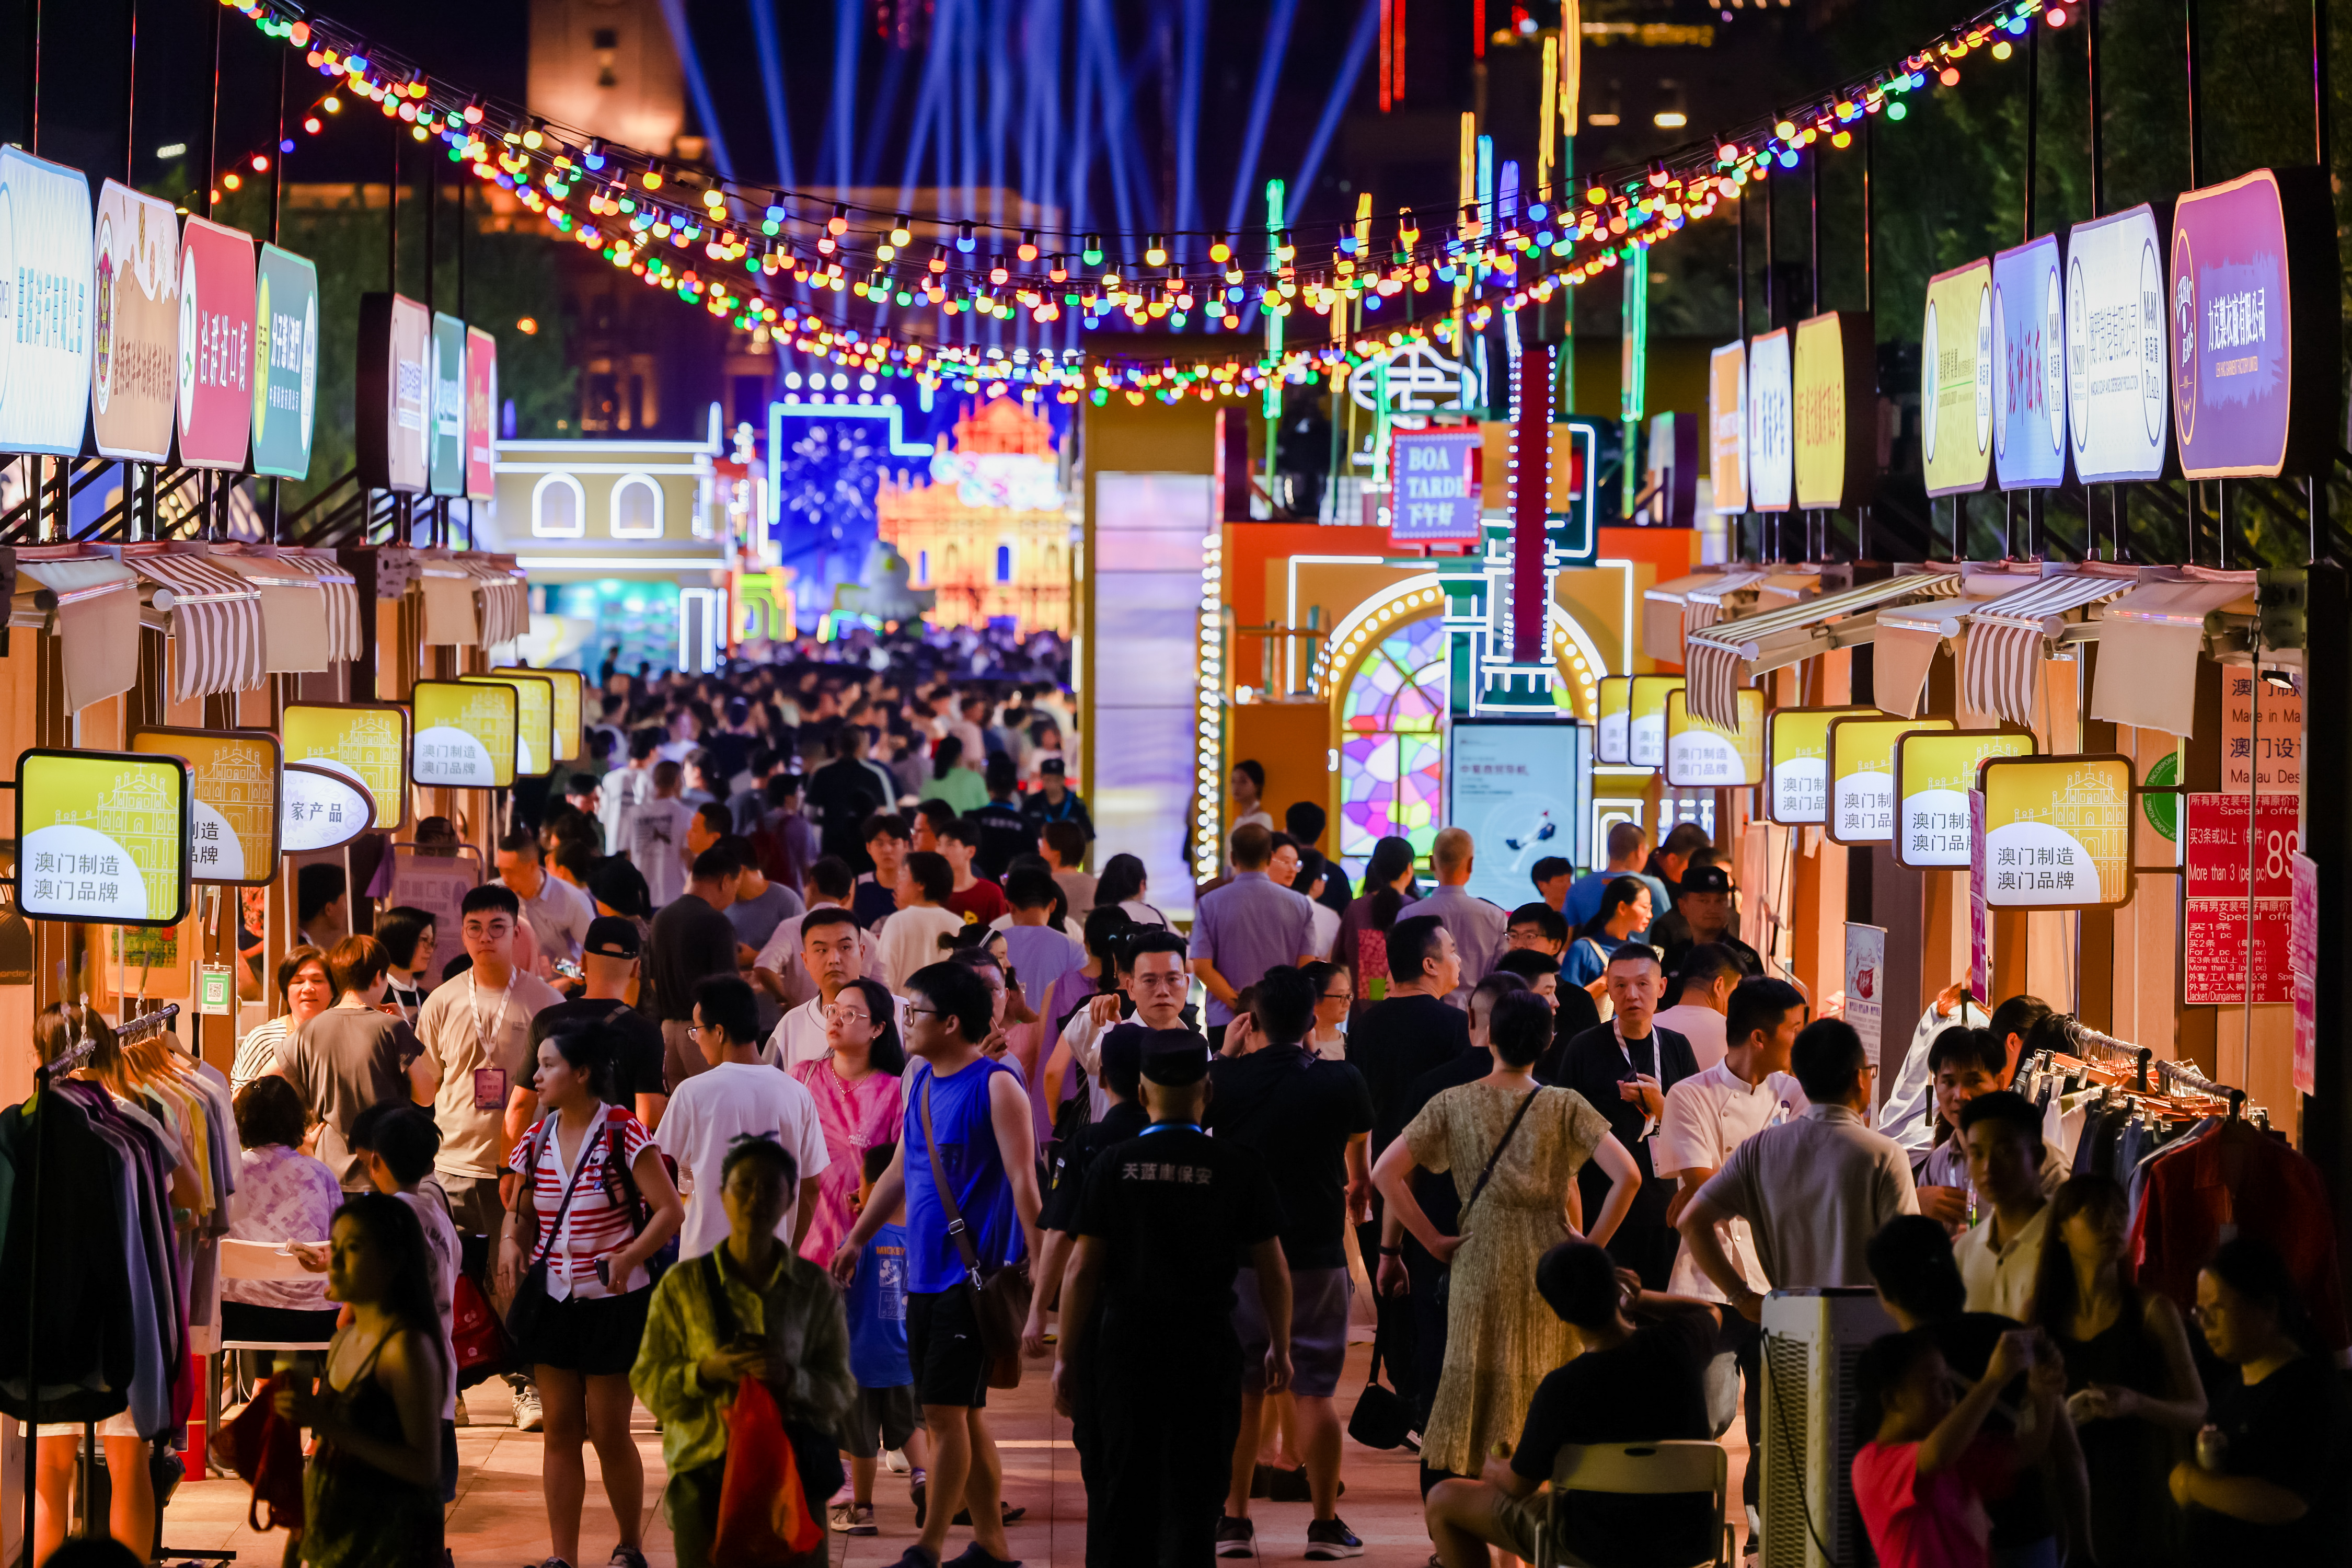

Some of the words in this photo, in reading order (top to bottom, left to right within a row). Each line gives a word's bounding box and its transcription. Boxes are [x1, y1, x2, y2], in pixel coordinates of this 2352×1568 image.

[2208, 286, 2265, 353] 力克製衣廠有限公司
[1408, 446, 1450, 471] BOA
[1406, 476, 1464, 498] TARDE
[1406, 502, 1455, 527] 下午好
[2269, 709, 2277, 722] in
[422, 745, 477, 759] 澳门制造
[1677, 747, 1727, 760] 澳门制造
[2230, 737, 2301, 758] 澳门设
[422, 761, 476, 776] 澳门品牌
[1677, 763, 1727, 776] 澳门品牌
[2231, 769, 2270, 783] Maau
[1844, 792, 1892, 809] 澳门制
[282, 801, 343, 823] 家产品
[2219, 806, 2263, 816] Specal
[1844, 813, 1892, 829] 澳门品
[2153, 817, 2170, 835] HONG
[2189, 827, 2237, 845] 买3条或以上
[34, 851, 120, 877] 澳门制造
[1997, 847, 2075, 866] 澳门制造
[1997, 871, 2075, 890] 澳门品牌
[2189, 863, 2208, 881] More
[2211, 863, 2227, 881] than
[2230, 863, 2235, 881] 3
[2239, 863, 2250, 883] (pe
[2256, 863, 2267, 883] pc)
[33, 878, 119, 904] 澳门品牌
[2218, 912, 2262, 921] Specal
[2189, 923, 2232, 931] 买1条
[2188, 939, 2216, 948] 买2条
[2278, 972, 2294, 981] Spe
[2188, 991, 2242, 1002] Jacket/Dungarees
[876, 1246, 906, 1255] MICKEY
